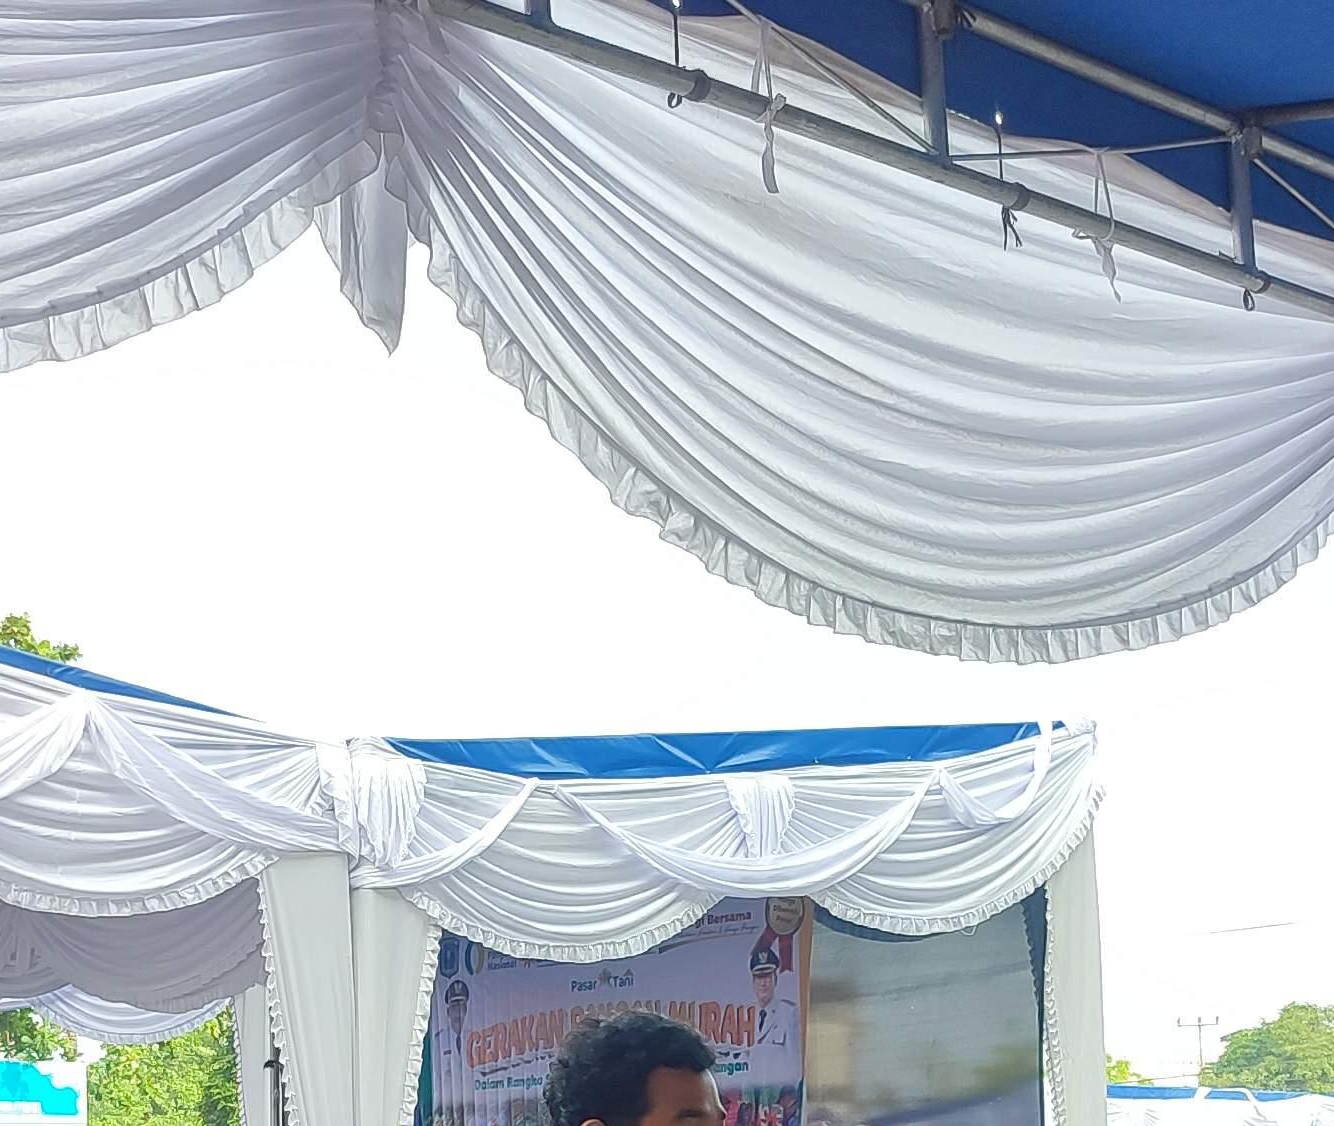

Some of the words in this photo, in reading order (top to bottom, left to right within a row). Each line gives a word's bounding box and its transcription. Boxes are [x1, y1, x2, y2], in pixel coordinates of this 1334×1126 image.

[707, 912, 752, 925] Bersama
[571, 979, 597, 992] Pasar
[613, 973, 634, 989] Tani
[467, 1007, 565, 1068] GERAKAN
[713, 1061, 749, 1076] angan
[475, 1078, 504, 1090] Dalam
